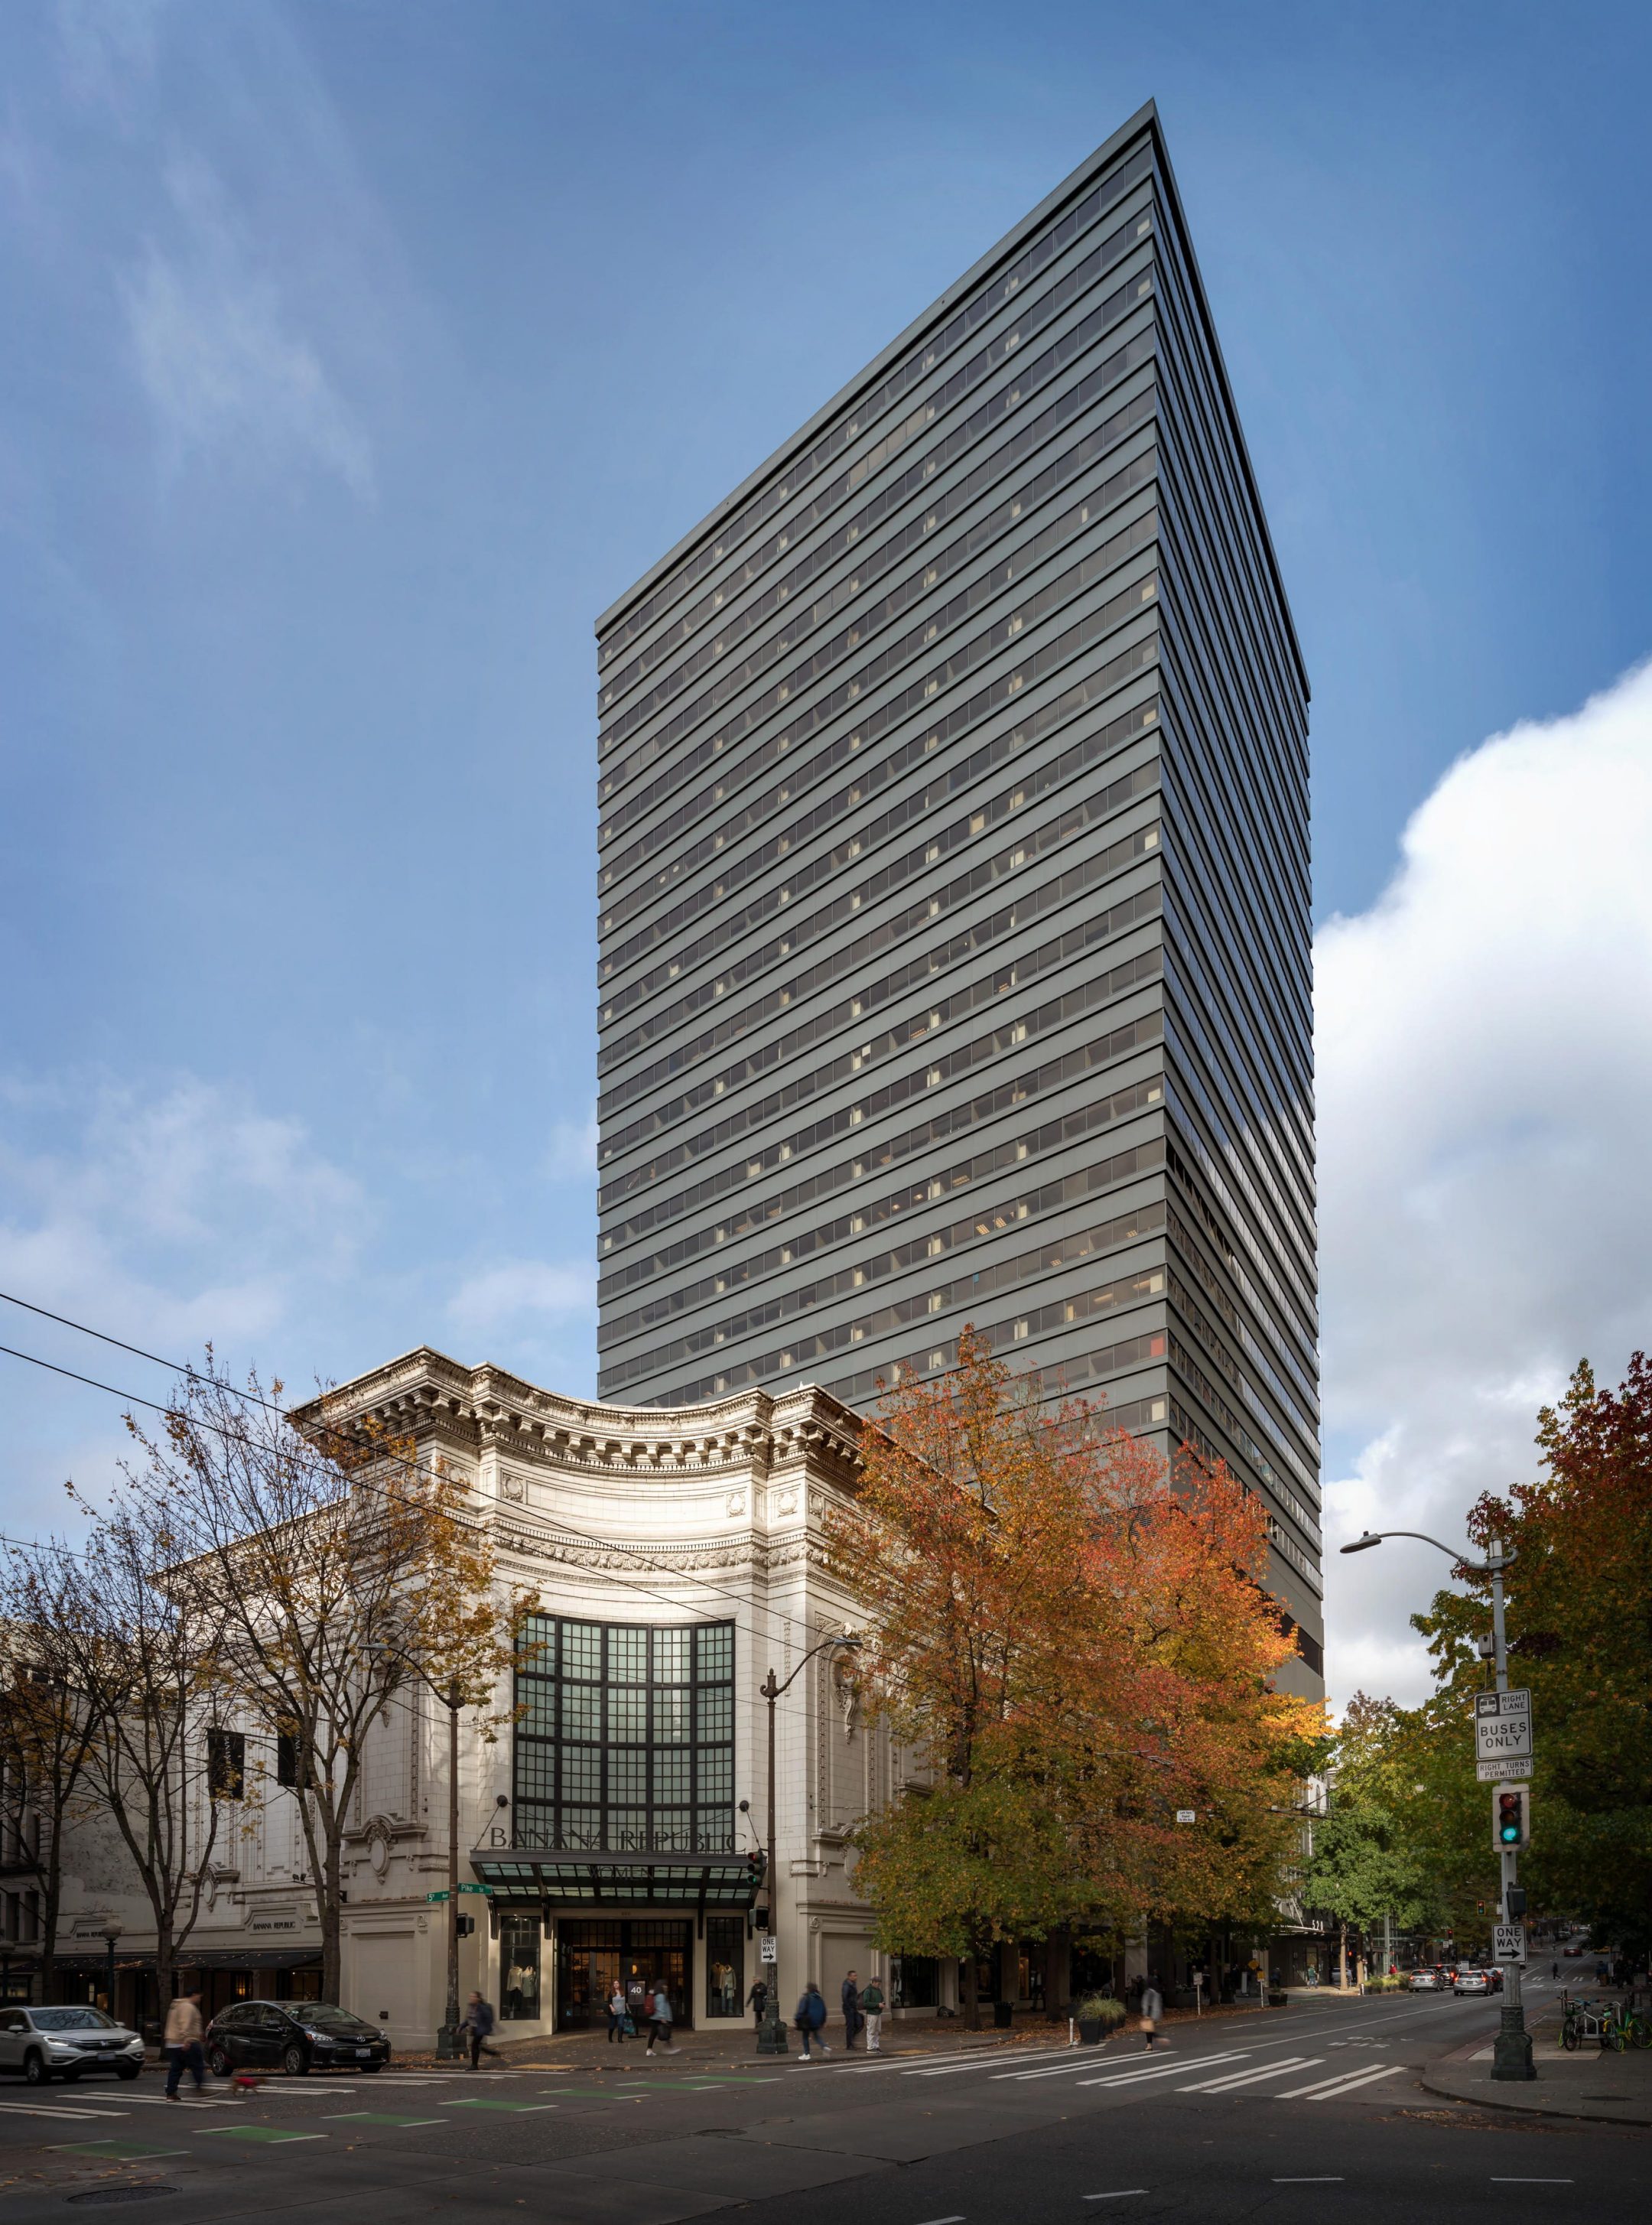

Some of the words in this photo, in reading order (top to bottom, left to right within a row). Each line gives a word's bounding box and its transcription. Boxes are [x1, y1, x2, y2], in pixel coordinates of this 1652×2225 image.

[1502, 1694, 1526, 1703] RIGHT
[1504, 1702, 1525, 1710] LANE
[1481, 1722, 1527, 1736] BUSES
[1486, 1735, 1521, 1748] ONLY
[1480, 1763, 1501, 1771] RIGHT
[1506, 1760, 1530, 1769] TURNS
[1485, 1768, 1525, 1778] PERMITTED
[490, 1827, 611, 1851] BANANA
[620, 1830, 747, 1853] REPUBLIC
[587, 1865, 655, 1881] WOMEN
[460, 1884, 473, 1892] Pike
[1497, 1927, 1521, 1937] ONE
[1497, 1937, 1522, 1947] WAY
